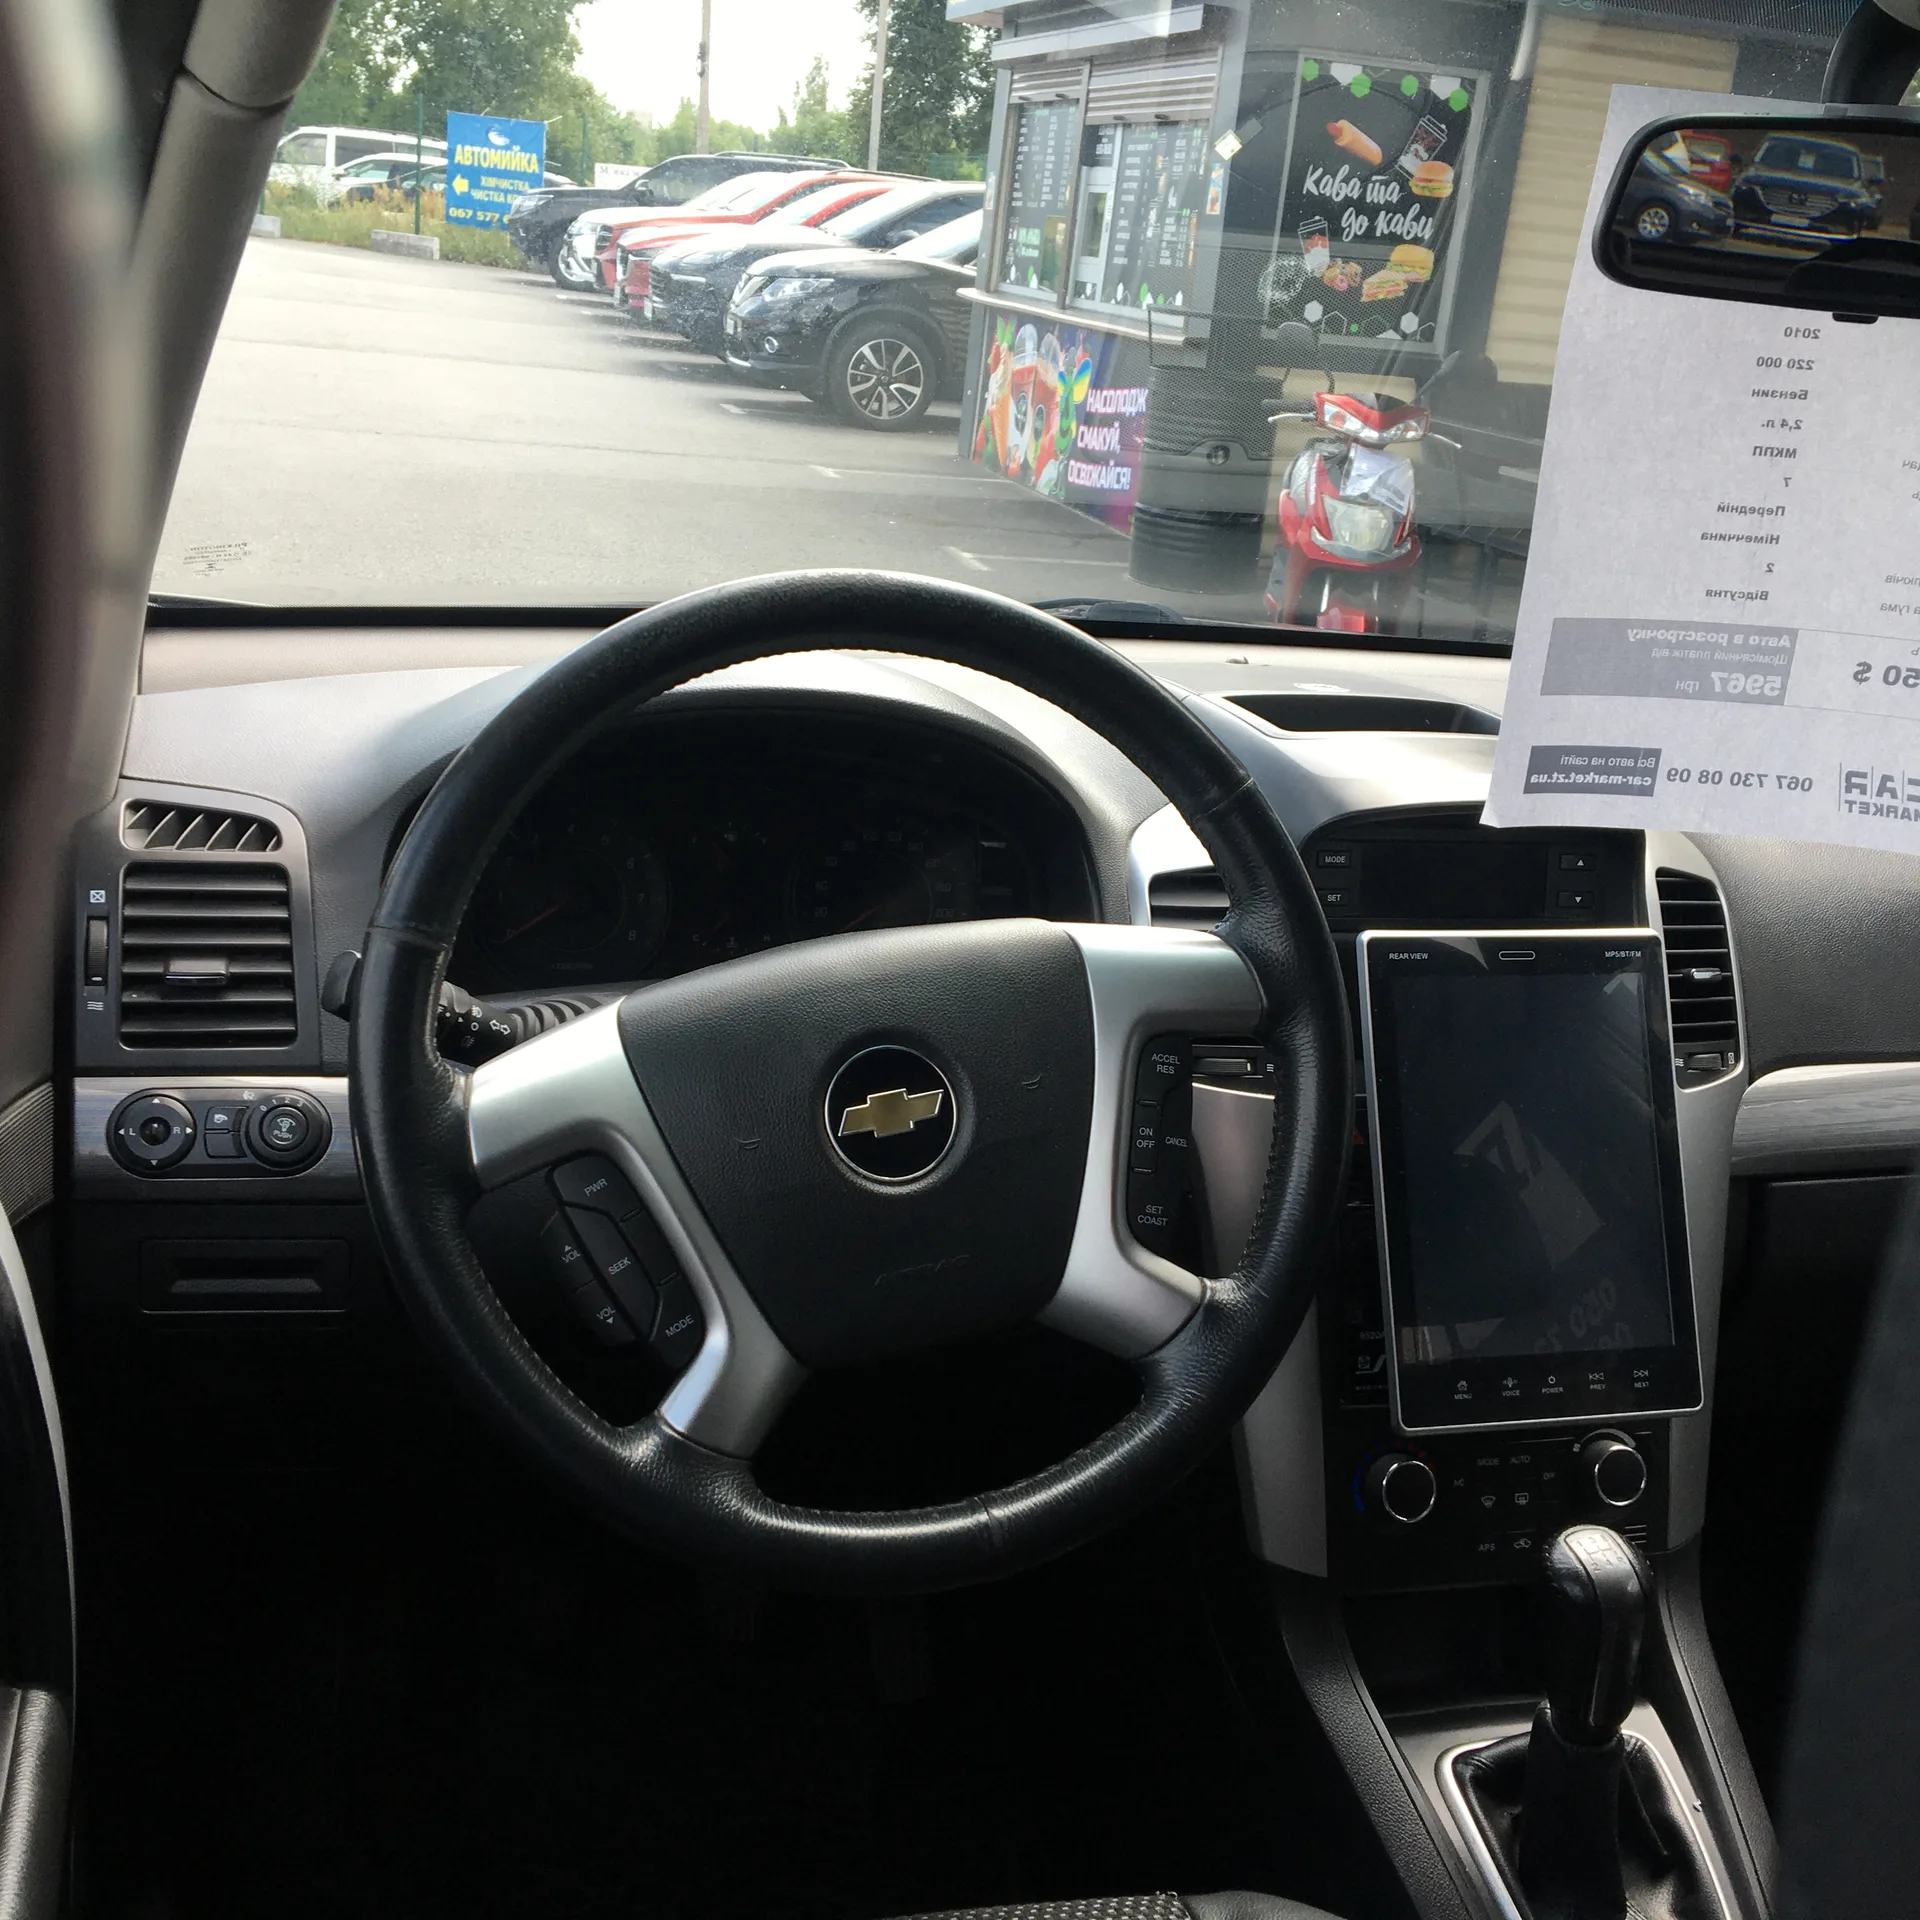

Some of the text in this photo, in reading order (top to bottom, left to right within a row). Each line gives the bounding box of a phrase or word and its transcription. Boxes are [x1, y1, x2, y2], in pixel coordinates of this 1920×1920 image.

[454, 143, 540, 174] АВТОМИЙКА
[480, 175, 530, 191] ХІМЧИСТКА
[1302, 164, 1402, 205] Кава та
[470, 188, 506, 203] ЧИСТКА
[448, 206, 473, 219] 067
[476, 210, 500, 222] 577
[1341, 203, 1434, 242] до кави
[1086, 387, 1149, 418] НАСОЛОДЖ
[1324, 855, 1346, 864] MODE
[1327, 894, 1342, 902] SET
[1389, 952, 1429, 960] REAR VIEW
[1151, 1053, 1180, 1064] ACCEL
[1156, 1064, 1175, 1074] RES
[128, 1127, 136, 1136] L
[173, 1126, 181, 1134] R
[273, 1129, 293, 1140] PUSH
[1138, 1127, 1154, 1136] ON
[1136, 1139, 1156, 1149] OFF
[1165, 1136, 1188, 1147] CANCEL
[583, 1178, 609, 1196] PWR
[1145, 1204, 1163, 1214] SET
[1137, 1214, 1168, 1226] COAST
[561, 1249, 582, 1264] VOL
[608, 1256, 631, 1275] SEEK
[596, 1306, 616, 1320] VOL
[665, 1314, 695, 1337] MODE
[1454, 1392, 1473, 1400] MENU
[1501, 1389, 1521, 1397] VOICE
[1477, 1458, 1500, 1466] MODE
[1509, 1456, 1531, 1464] AUTO
